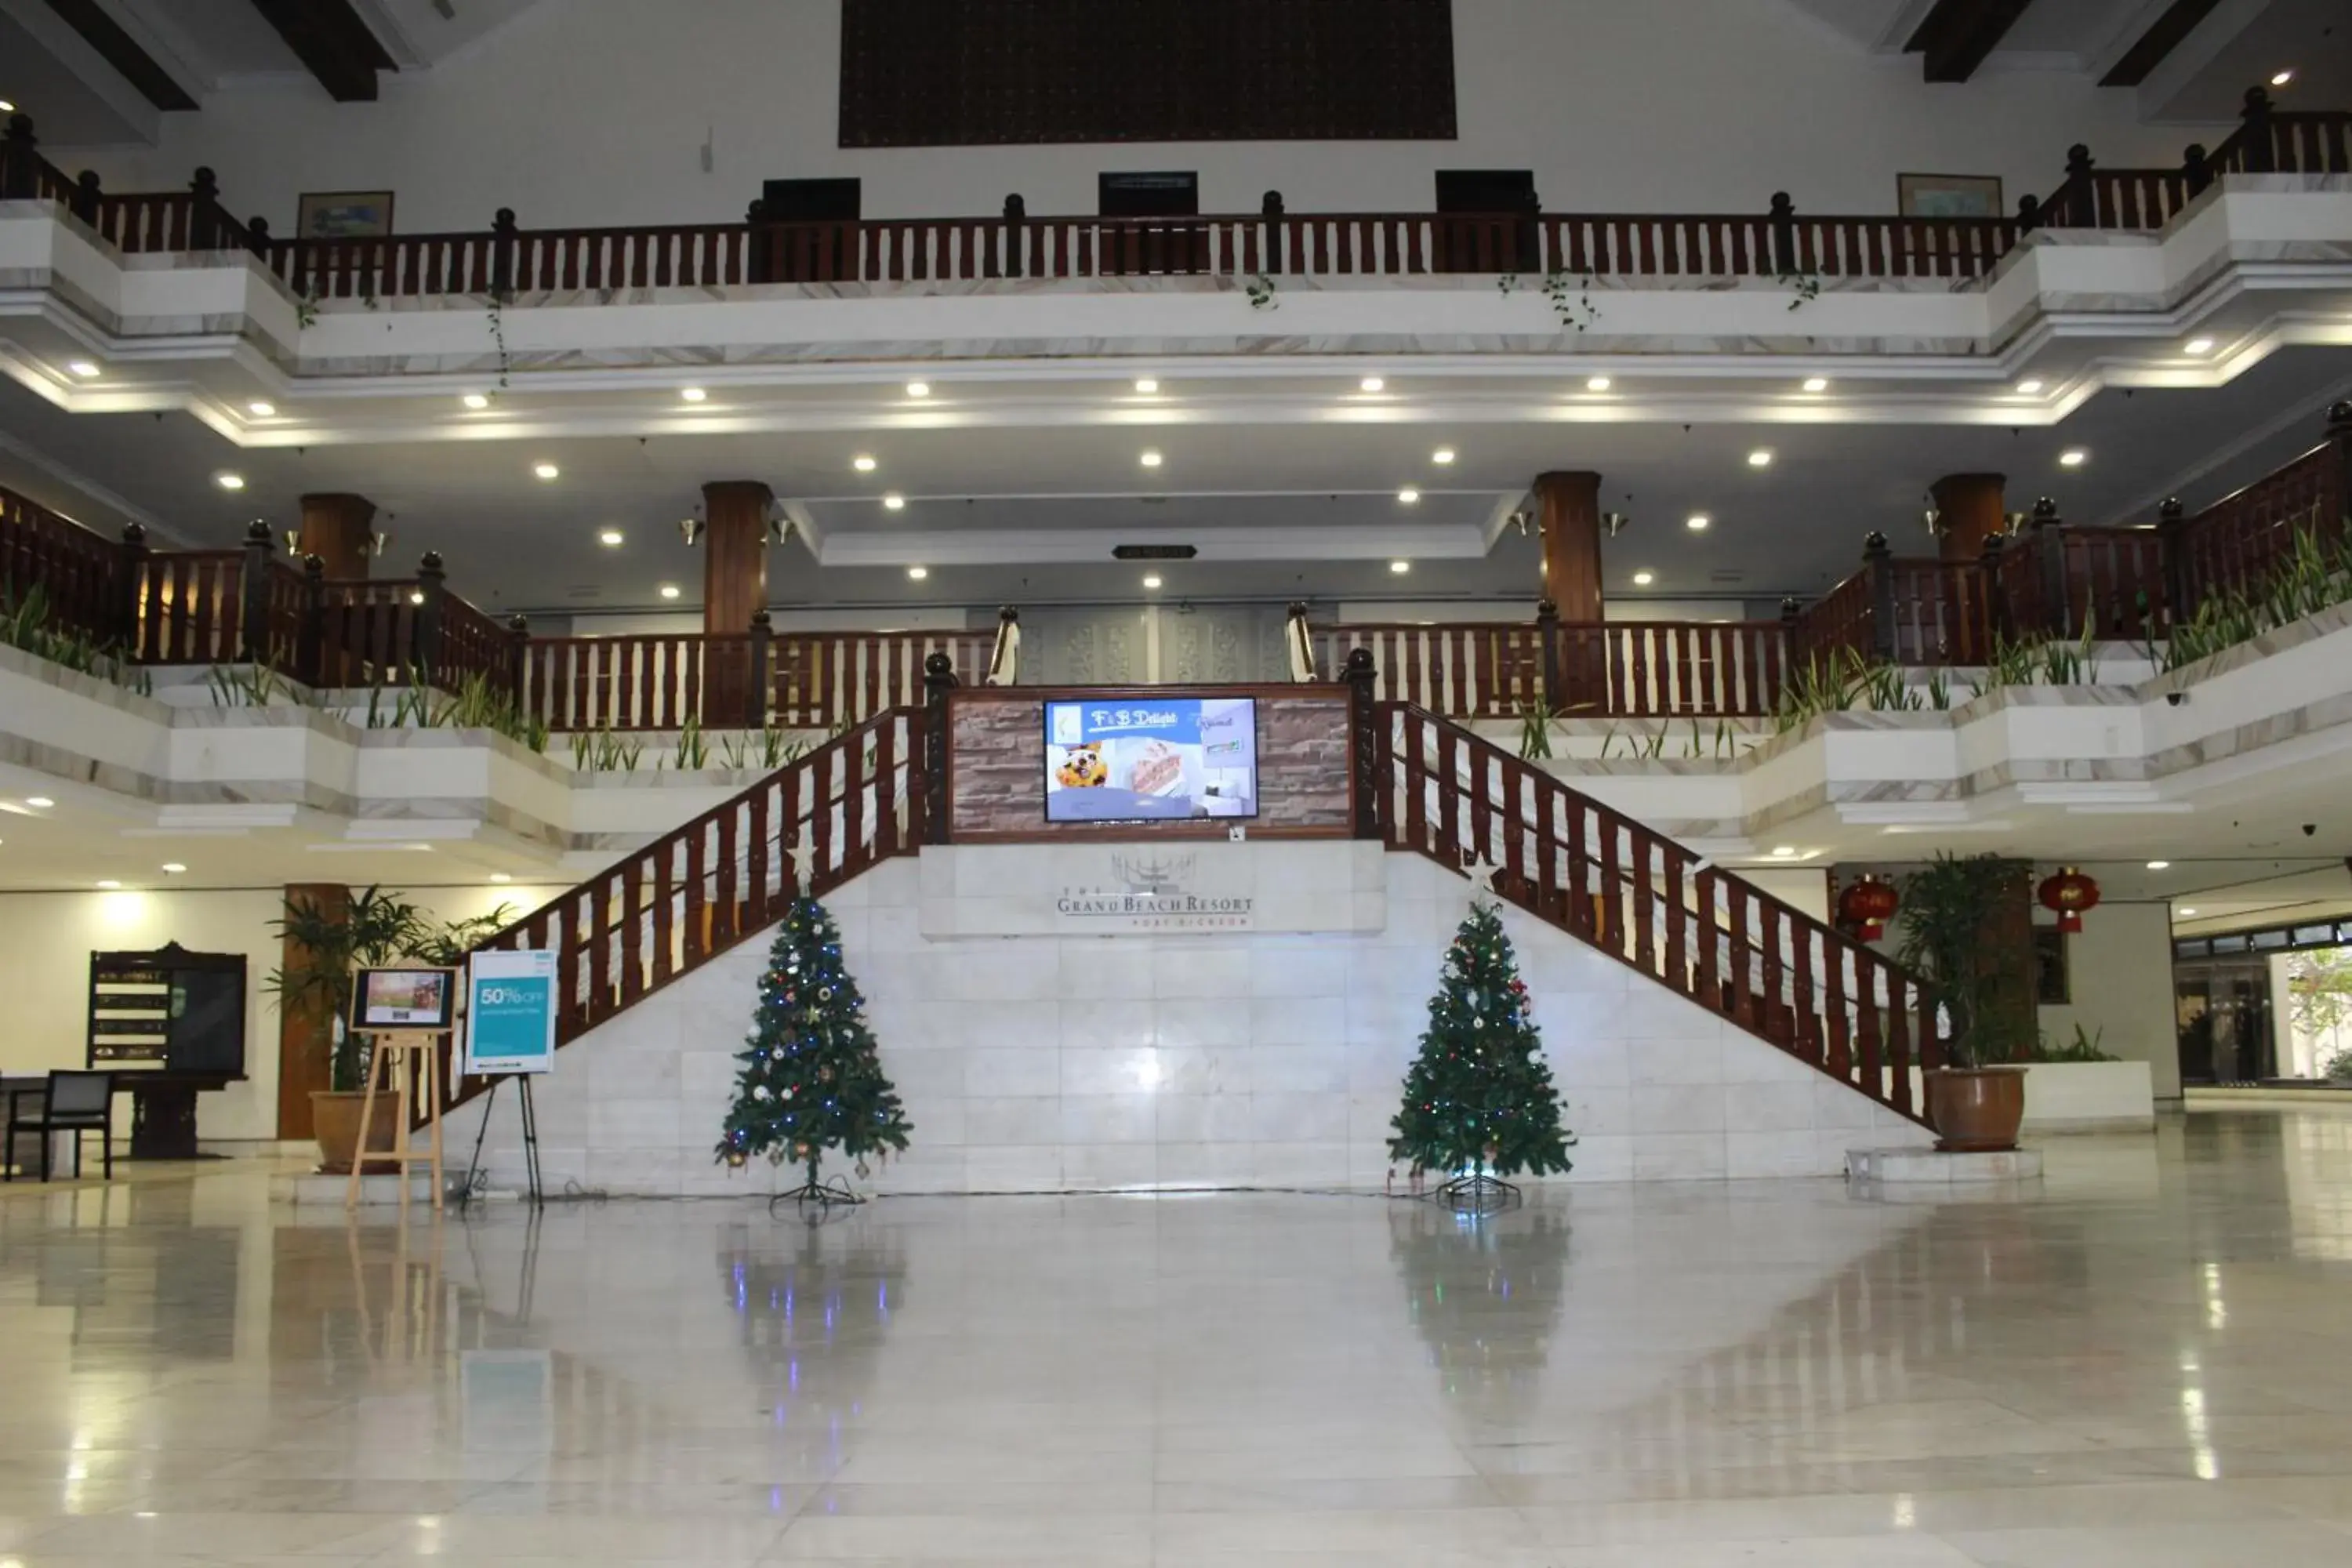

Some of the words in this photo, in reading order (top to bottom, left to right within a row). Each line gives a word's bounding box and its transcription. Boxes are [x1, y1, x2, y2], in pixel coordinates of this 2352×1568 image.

[1058, 897, 1118, 913] GRAND
[1123, 896, 1181, 912] BEACH
[1186, 895, 1254, 912] RESORT
